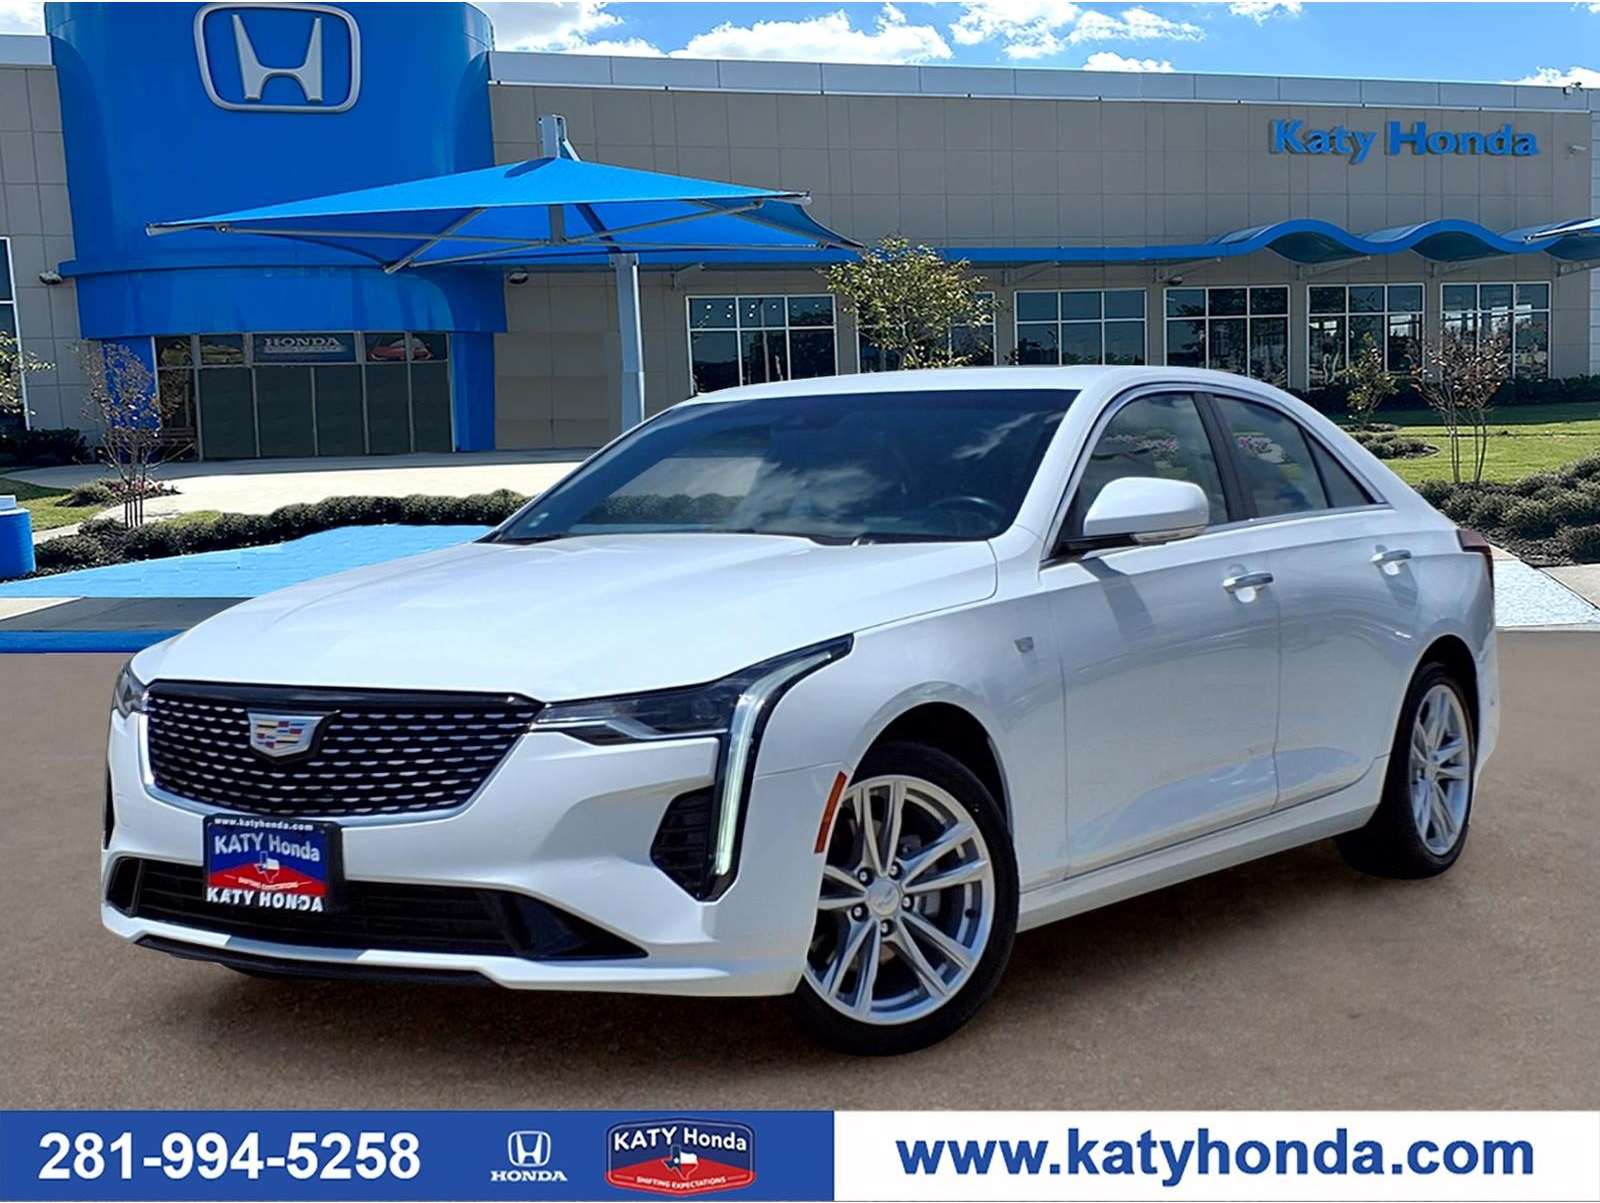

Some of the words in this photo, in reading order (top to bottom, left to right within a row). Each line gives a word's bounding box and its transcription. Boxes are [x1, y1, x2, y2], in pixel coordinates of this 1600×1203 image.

[1270, 119, 1376, 164] Katy
[1386, 120, 1538, 156] Honda
[264, 337, 341, 347] HONDA
[214, 818, 313, 831] www.katyhonda.com
[214, 832, 263, 855] KATY
[268, 834, 320, 862] Honda
[206, 887, 254, 905] KATY
[259, 892, 323, 912] HONDA
